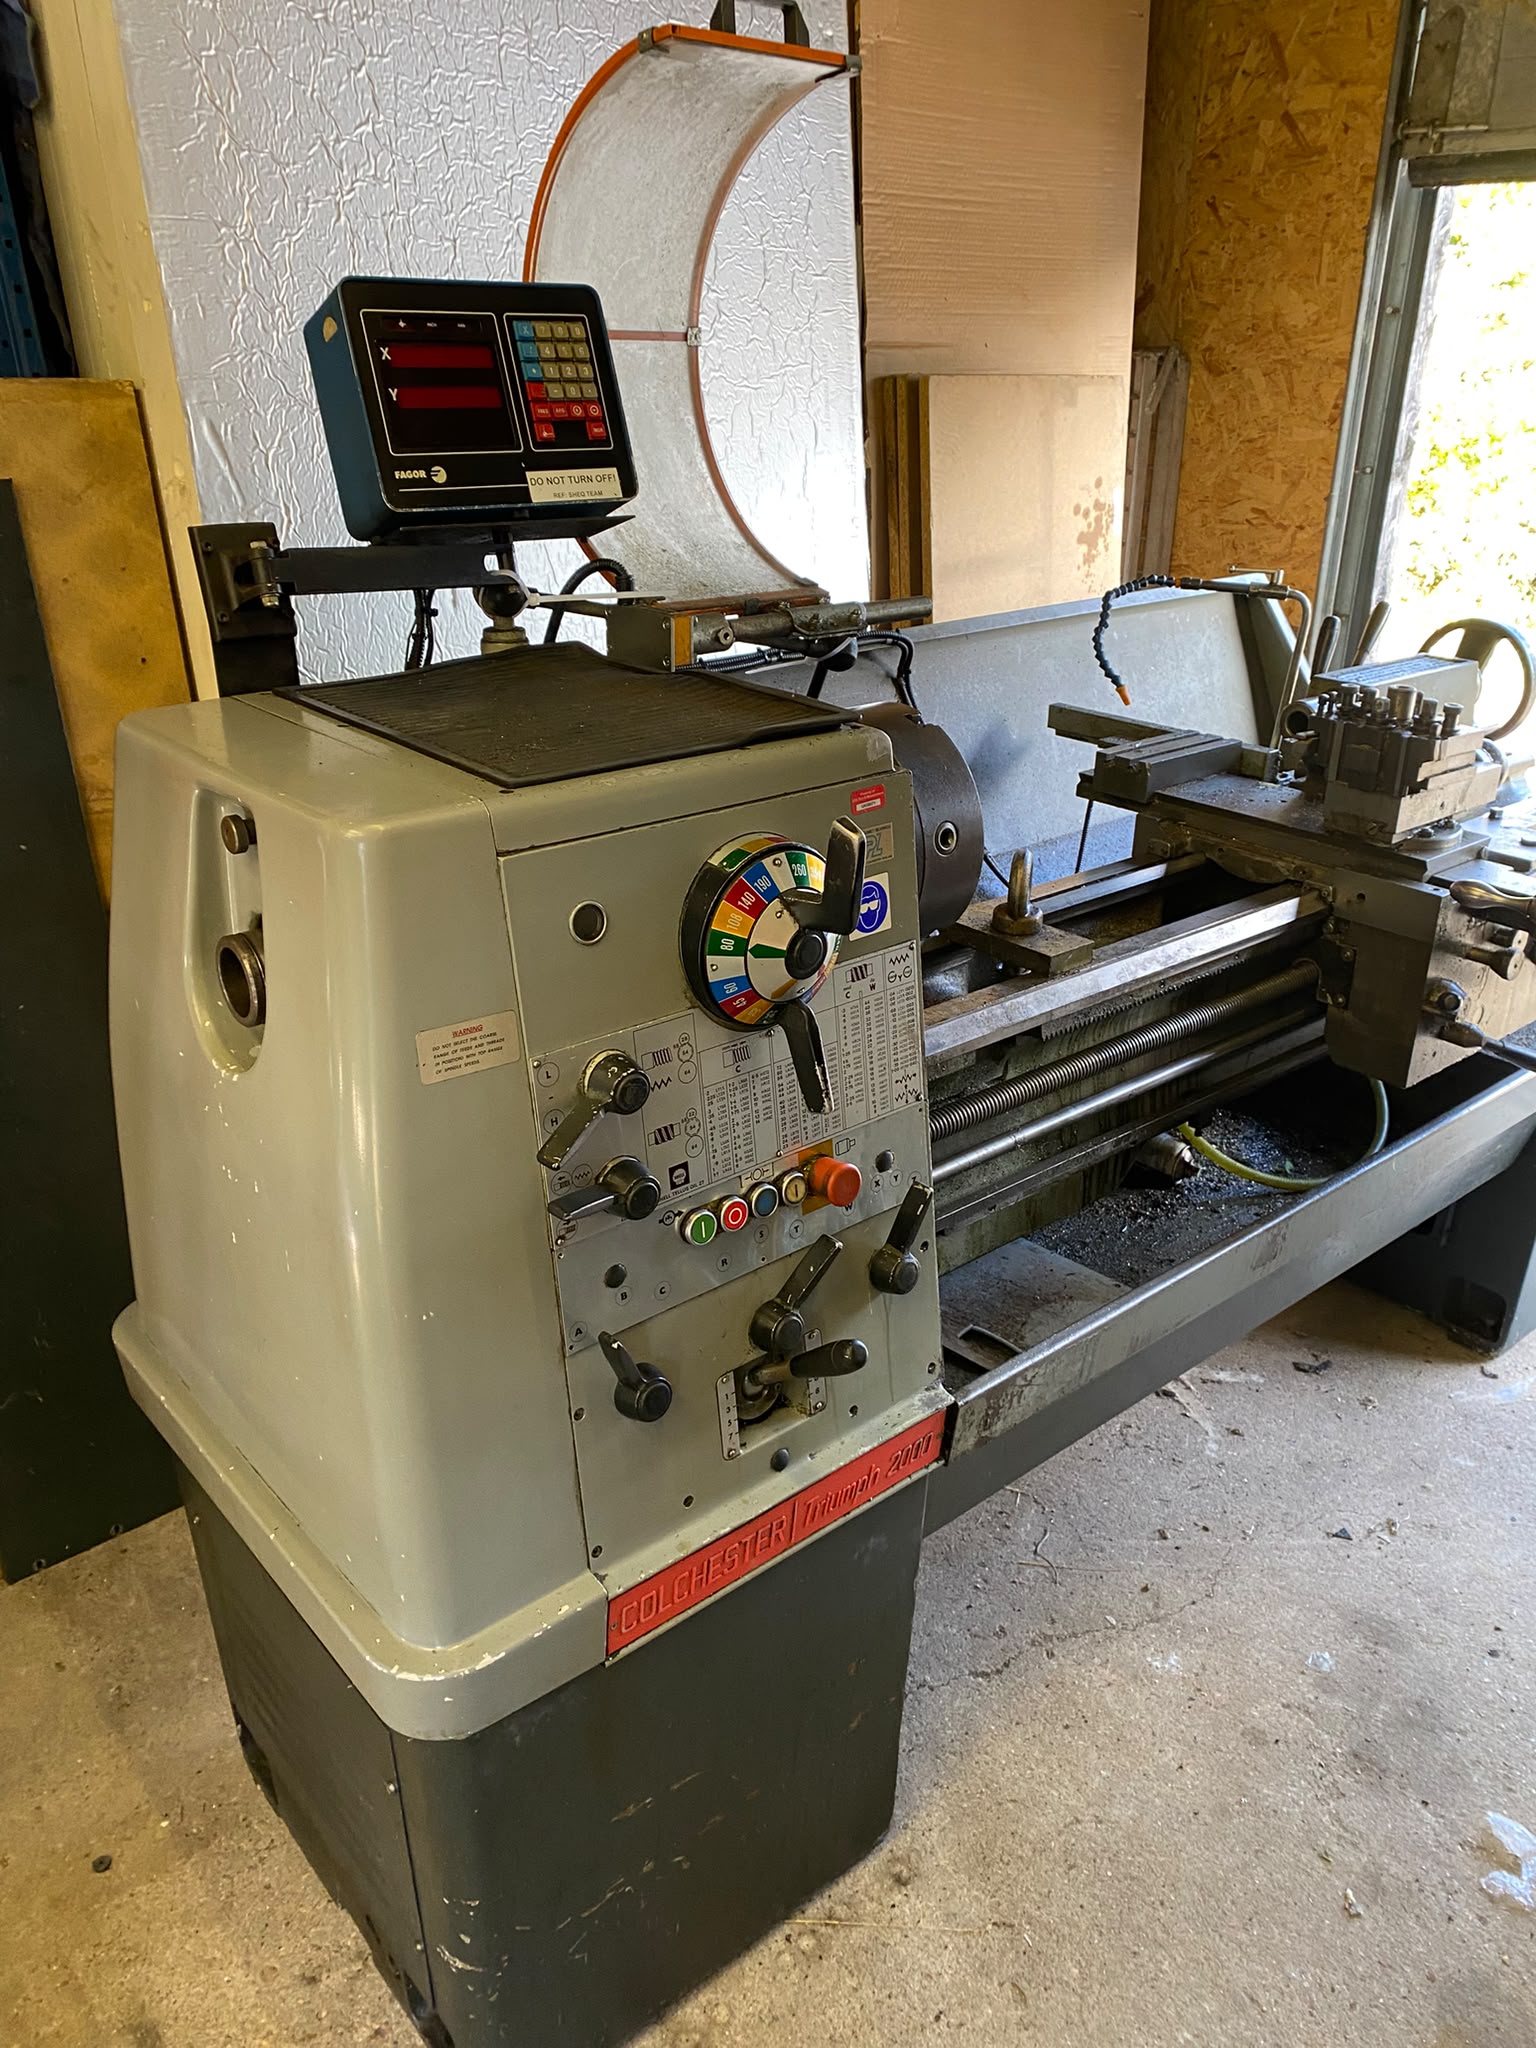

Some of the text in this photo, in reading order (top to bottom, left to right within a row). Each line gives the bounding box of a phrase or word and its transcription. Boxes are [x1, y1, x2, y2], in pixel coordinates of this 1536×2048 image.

[379, 346, 392, 361] X
[387, 388, 398, 401] Y
[394, 470, 428, 480] FAGOR
[530, 473, 617, 487] DO NOT TURN OFF!
[586, 490, 604, 498] TEAM
[791, 863, 808, 877] 260
[753, 874, 772, 893] 190
[737, 891, 756, 910] 140
[726, 912, 743, 931] 108
[719, 938, 735, 951] 80
[723, 982, 738, 994] 60
[451, 1024, 483, 1038] WARNING
[735, 1064, 741, 1073] C
[550, 1117, 559, 1126] H
[893, 1174, 899, 1182] Y
[874, 1179, 881, 1188] X
[758, 1229, 765, 1239] S
[793, 1225, 800, 1234] T
[721, 1258, 728, 1268] R
[659, 1286, 666, 1295] C
[620, 1291, 628, 1301] B
[574, 1327, 584, 1337] A
[621, 1431, 935, 1635] COLCHESTER Triumph 2000
